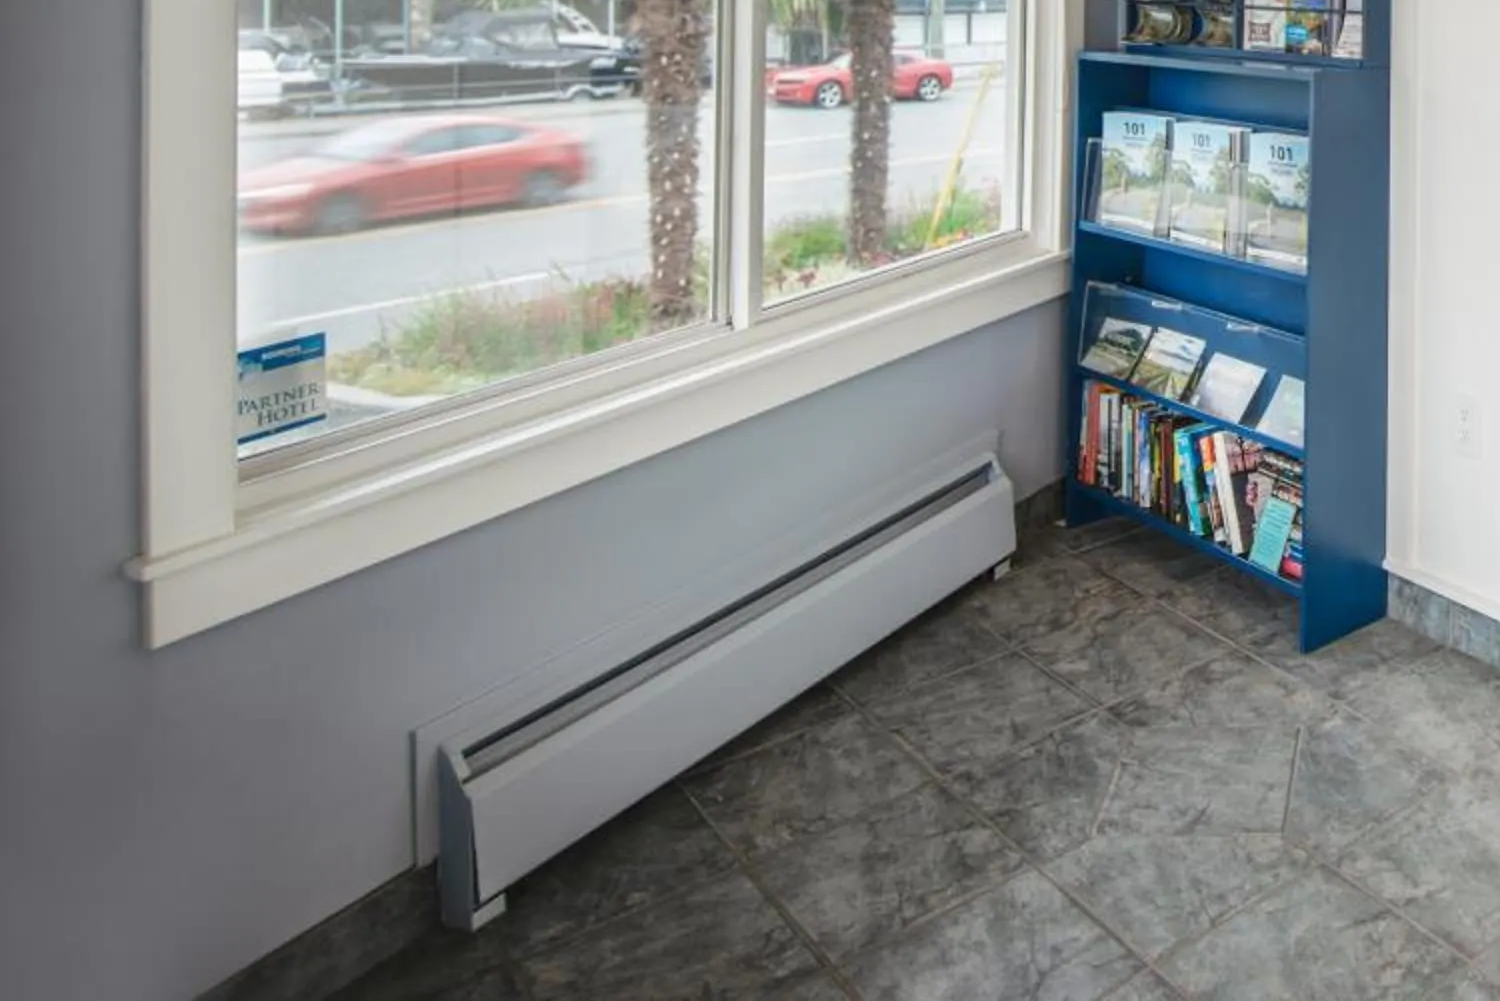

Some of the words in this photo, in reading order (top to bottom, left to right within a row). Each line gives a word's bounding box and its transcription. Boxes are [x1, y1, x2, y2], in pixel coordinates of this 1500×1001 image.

[1124, 122, 1145, 135] 101
[1193, 132, 1211, 147] 101
[1270, 145, 1293, 161] 101
[238, 381, 320, 415] PARTNER
[257, 398, 316, 426] HOTEL
